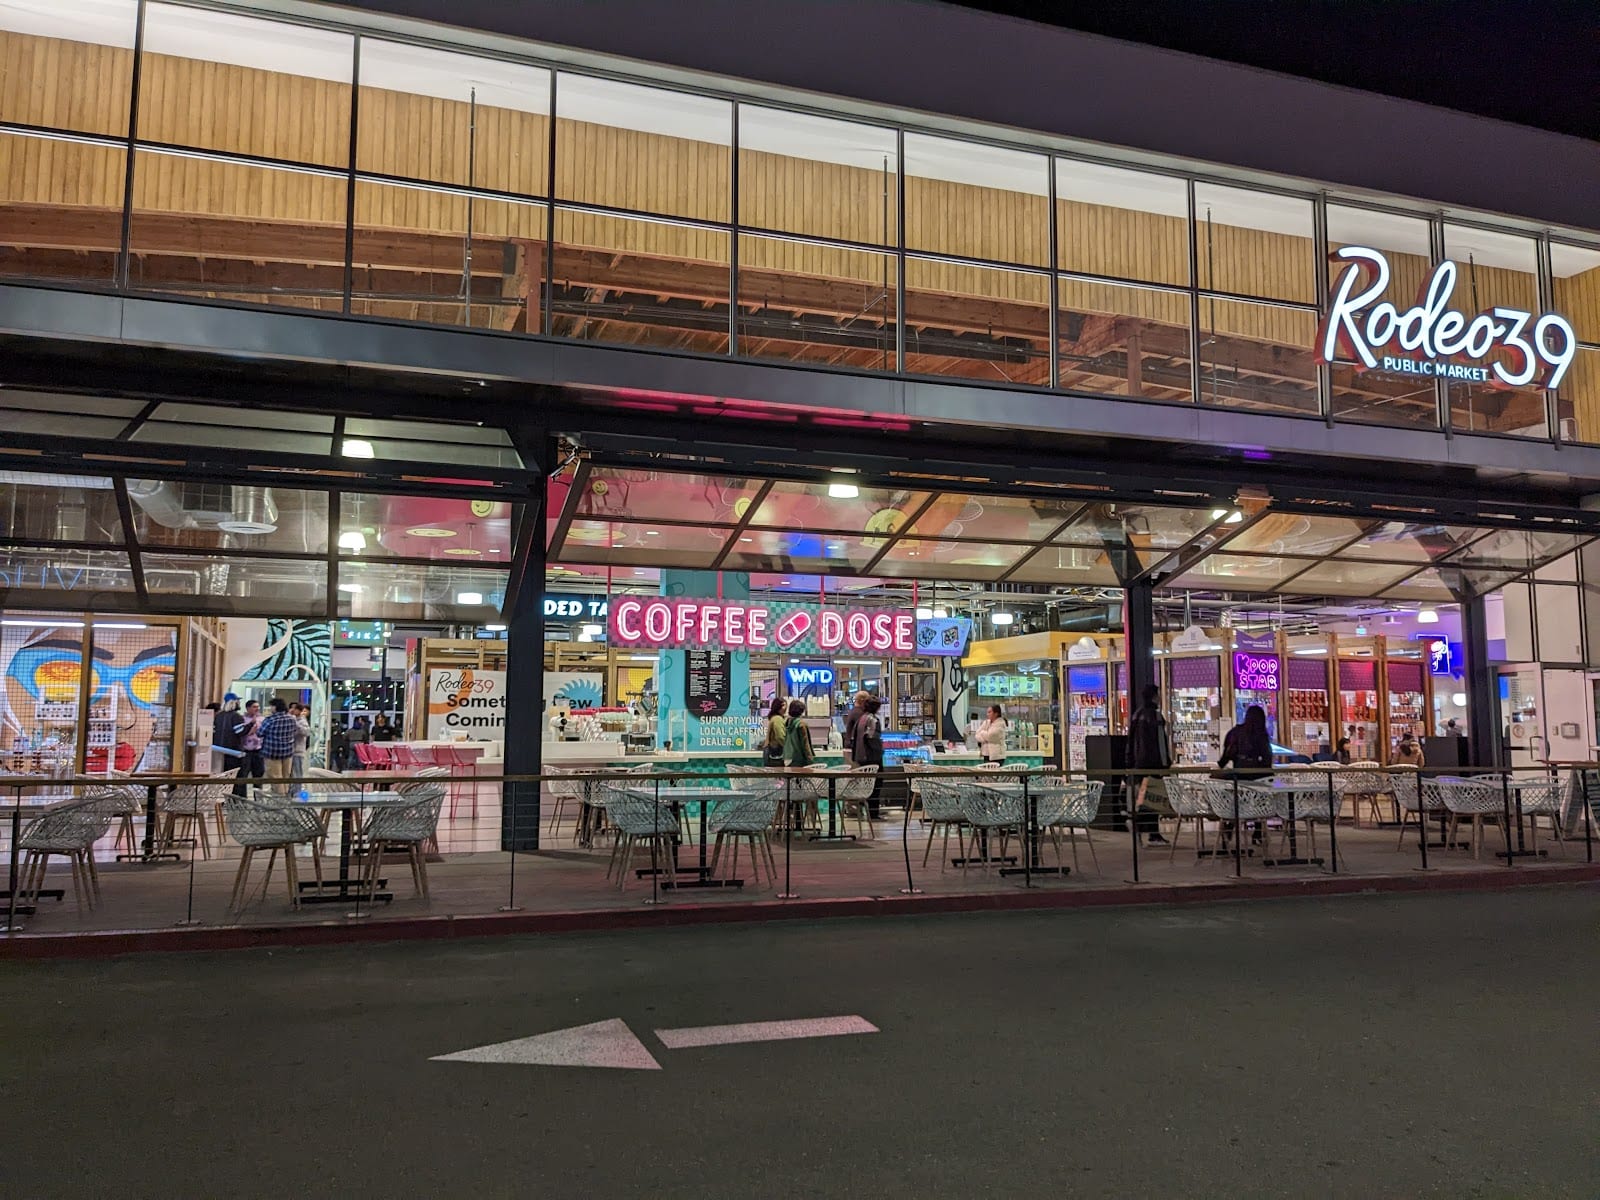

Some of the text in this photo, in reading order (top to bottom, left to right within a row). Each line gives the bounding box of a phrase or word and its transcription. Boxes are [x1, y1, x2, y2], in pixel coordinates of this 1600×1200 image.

[1383, 356, 1489, 381] PUBLIC MARKET
[543, 599, 608, 616] DED TA
[617, 601, 913, 649] COFFEE DOSE
[348, 631, 380, 640] FIKA
[1239, 674, 1278, 689] STAR
[447, 693, 506, 708] Somet
[446, 712, 506, 727] Comin
[700, 715, 764, 725] SUPPORT YOUR
[700, 726, 769, 736] LOCAL CAFFEINE
[700, 737, 735, 746] DEALER.
